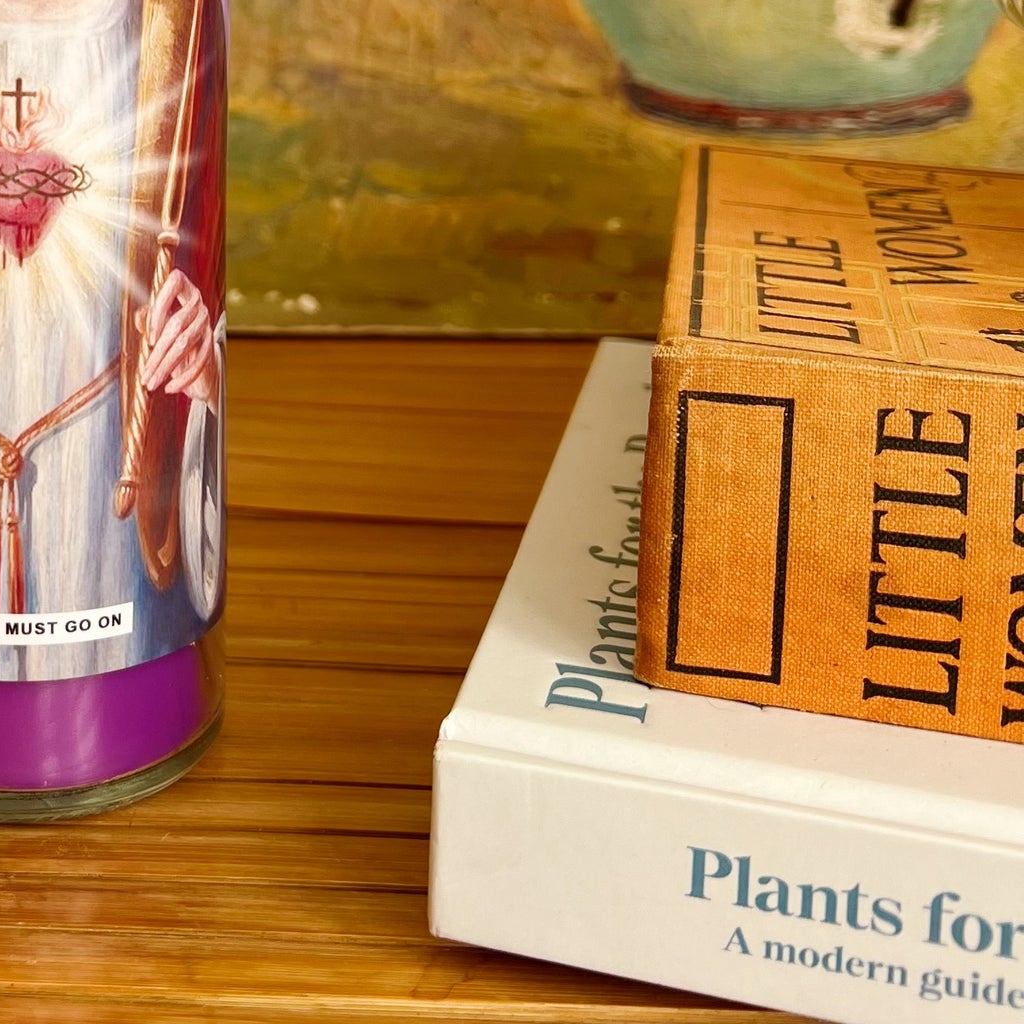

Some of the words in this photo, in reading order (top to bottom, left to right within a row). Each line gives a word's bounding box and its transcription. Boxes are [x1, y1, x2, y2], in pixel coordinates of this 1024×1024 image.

[754, 230, 861, 345] LITTLE
[863, 180, 980, 285] WOMEN
[862, 406, 972, 716] LITTLE
[5, 621, 59, 636] MUST
[65, 619, 92, 633] GO
[98, 613, 123, 629] ON
[684, 845, 904, 937] Plants
[922, 891, 1024, 960] for
[722, 926, 753, 956] A
[763, 939, 909, 987] modern
[919, 968, 1024, 1010] guide
